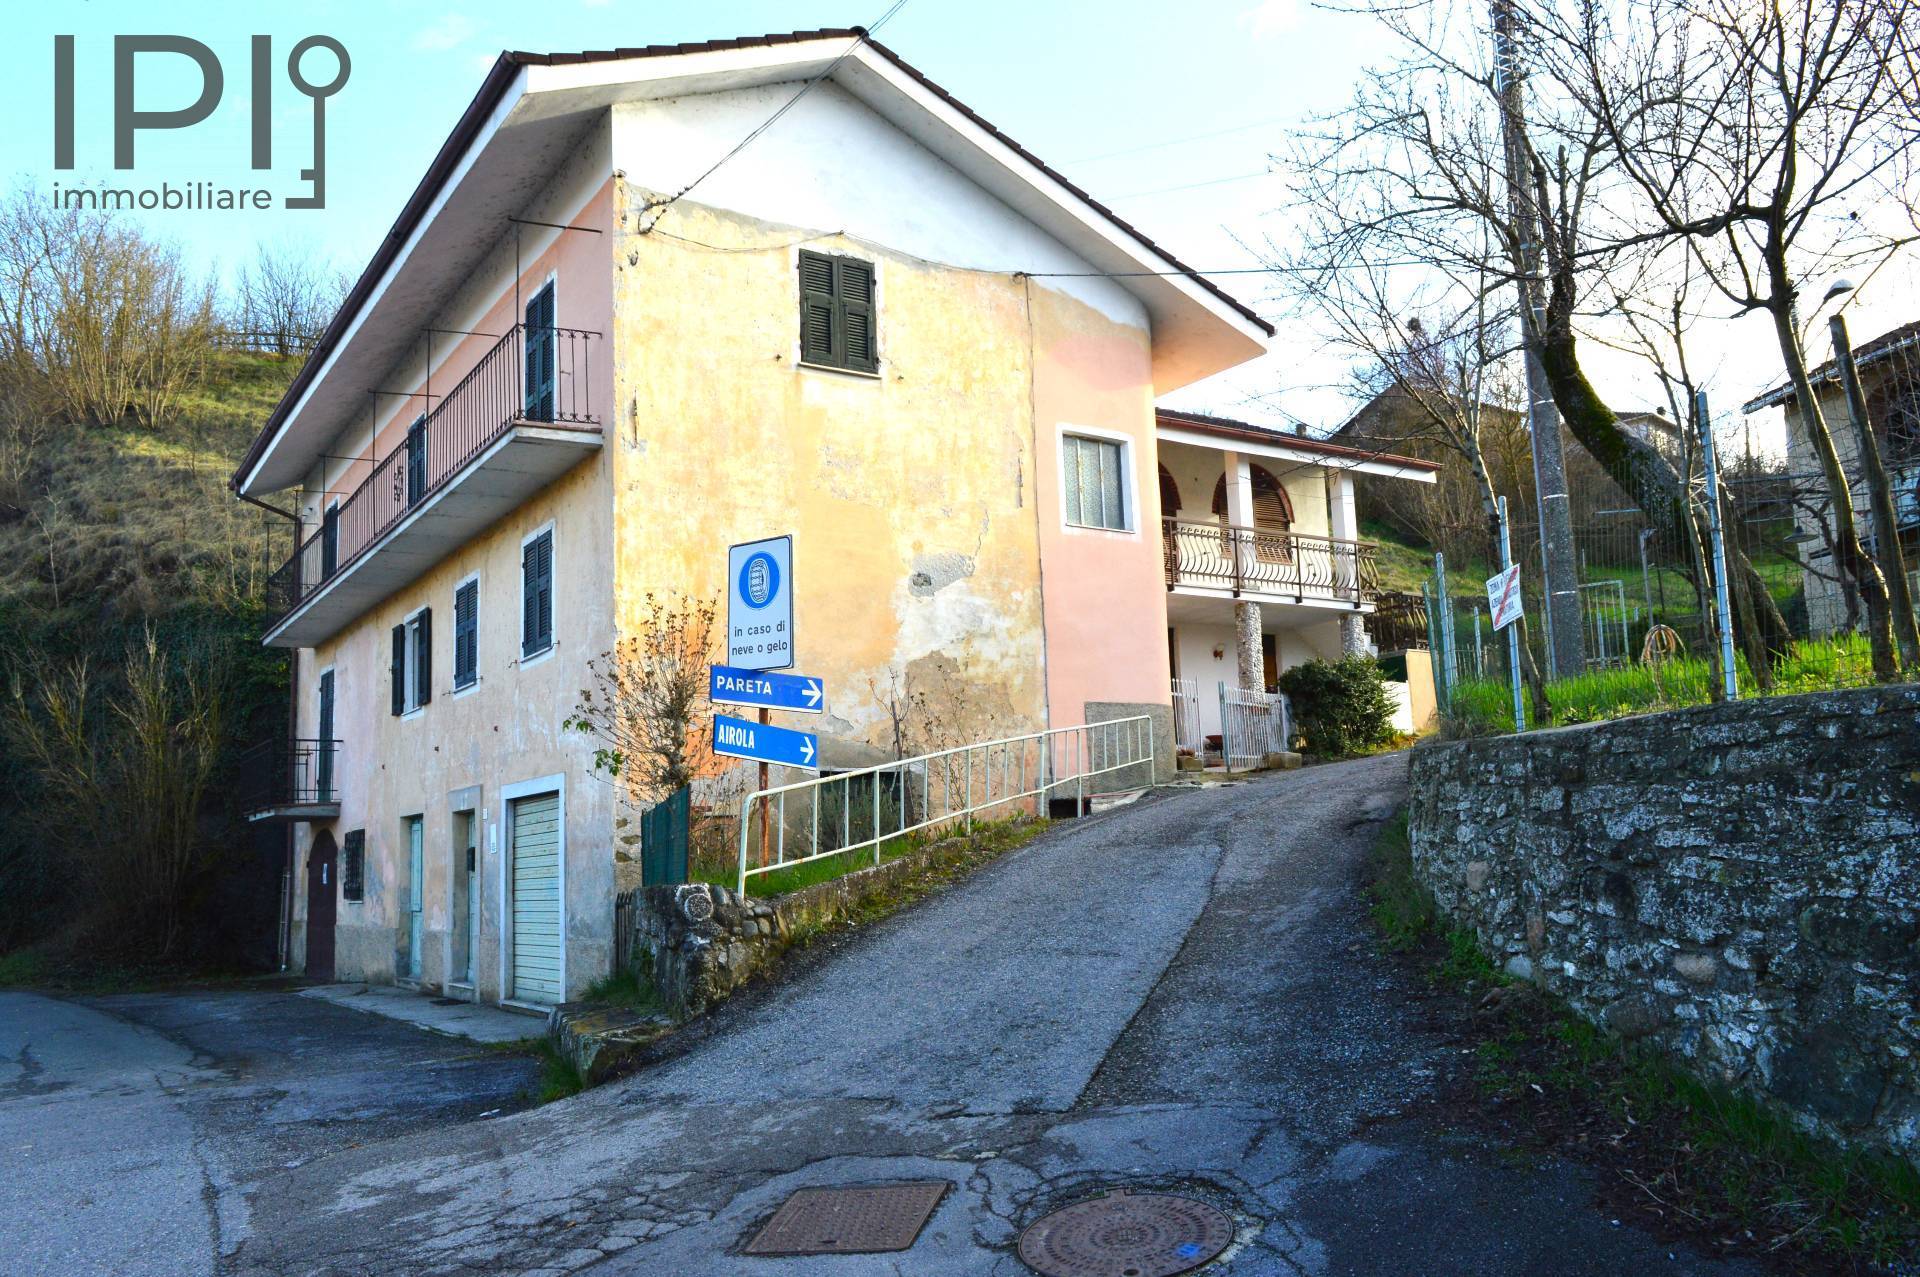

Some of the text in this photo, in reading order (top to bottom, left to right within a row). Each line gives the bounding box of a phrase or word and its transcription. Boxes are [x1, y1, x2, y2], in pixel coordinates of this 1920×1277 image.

[734, 620, 786, 637] in caso di
[732, 639, 788, 656] neve o gelo
[716, 675, 772, 696] PARETA
[717, 723, 755, 749] AIROLA
